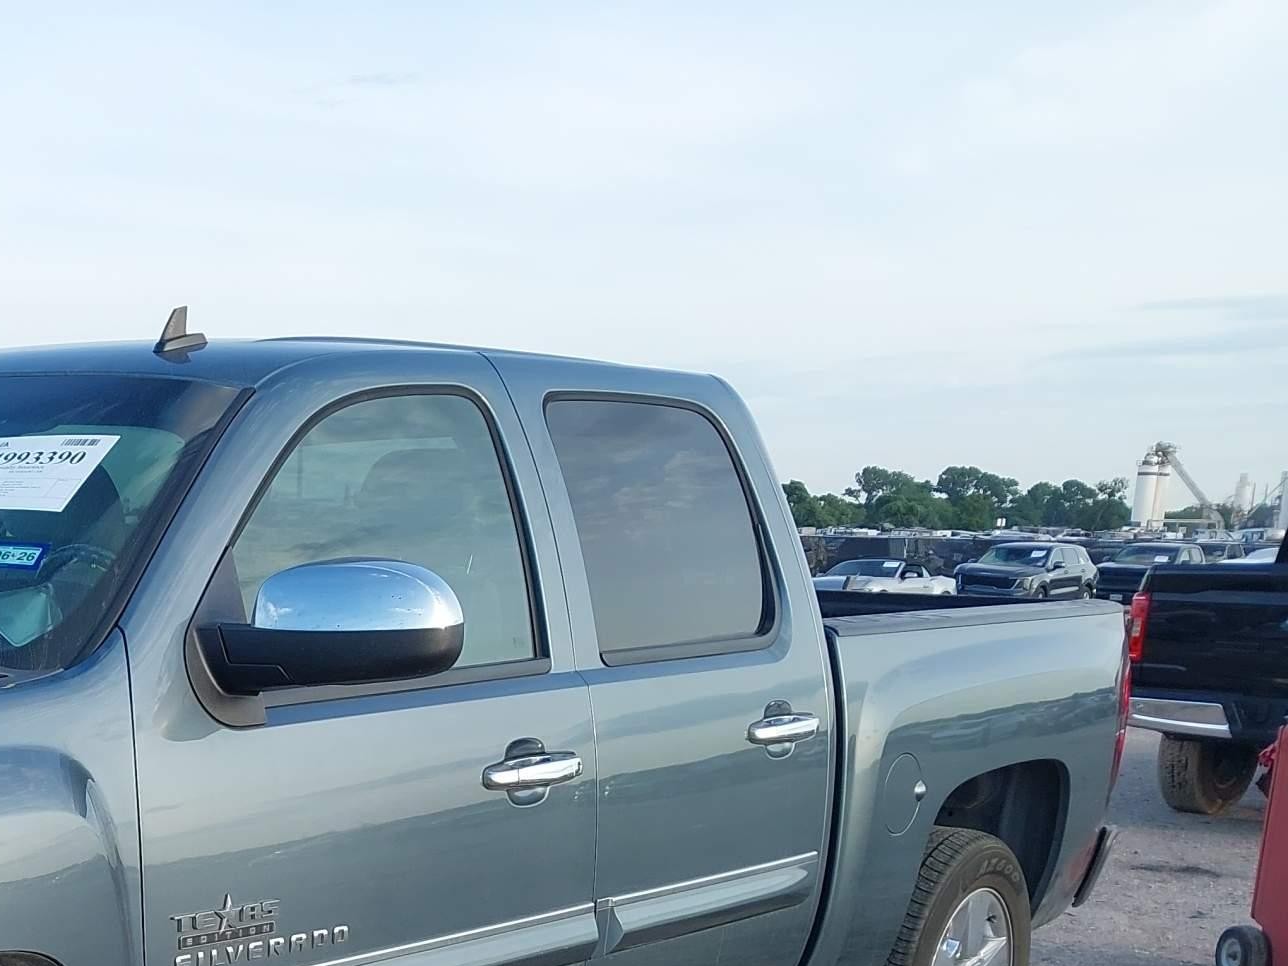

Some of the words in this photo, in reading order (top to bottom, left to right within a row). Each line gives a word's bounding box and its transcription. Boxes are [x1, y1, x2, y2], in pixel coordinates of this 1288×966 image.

[16, 551, 37, 561] 26
[169, 894, 281, 933] TEXAS
[185, 923, 271, 946] EDITION
